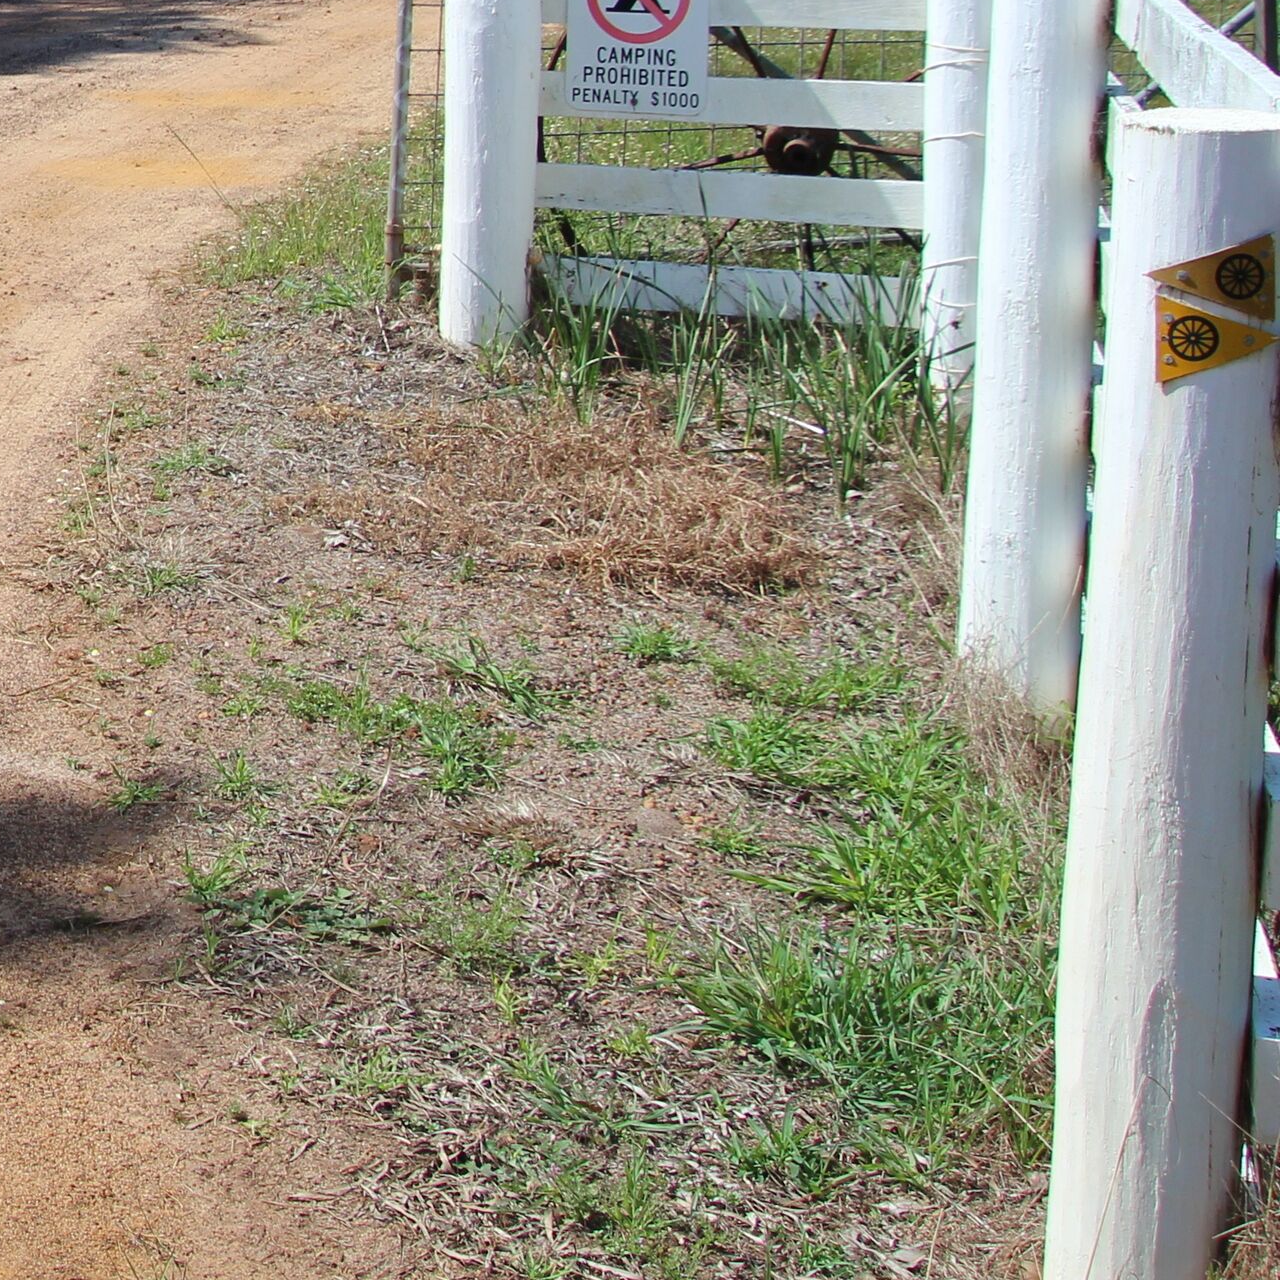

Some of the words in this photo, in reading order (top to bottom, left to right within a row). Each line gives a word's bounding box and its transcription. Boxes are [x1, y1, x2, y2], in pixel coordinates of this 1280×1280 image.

[597, 46, 676, 67] CAMPING
[583, 66, 689, 87] PROHIBITED
[572, 87, 638, 108] PENALTY
[651, 91, 700, 109] $1000
